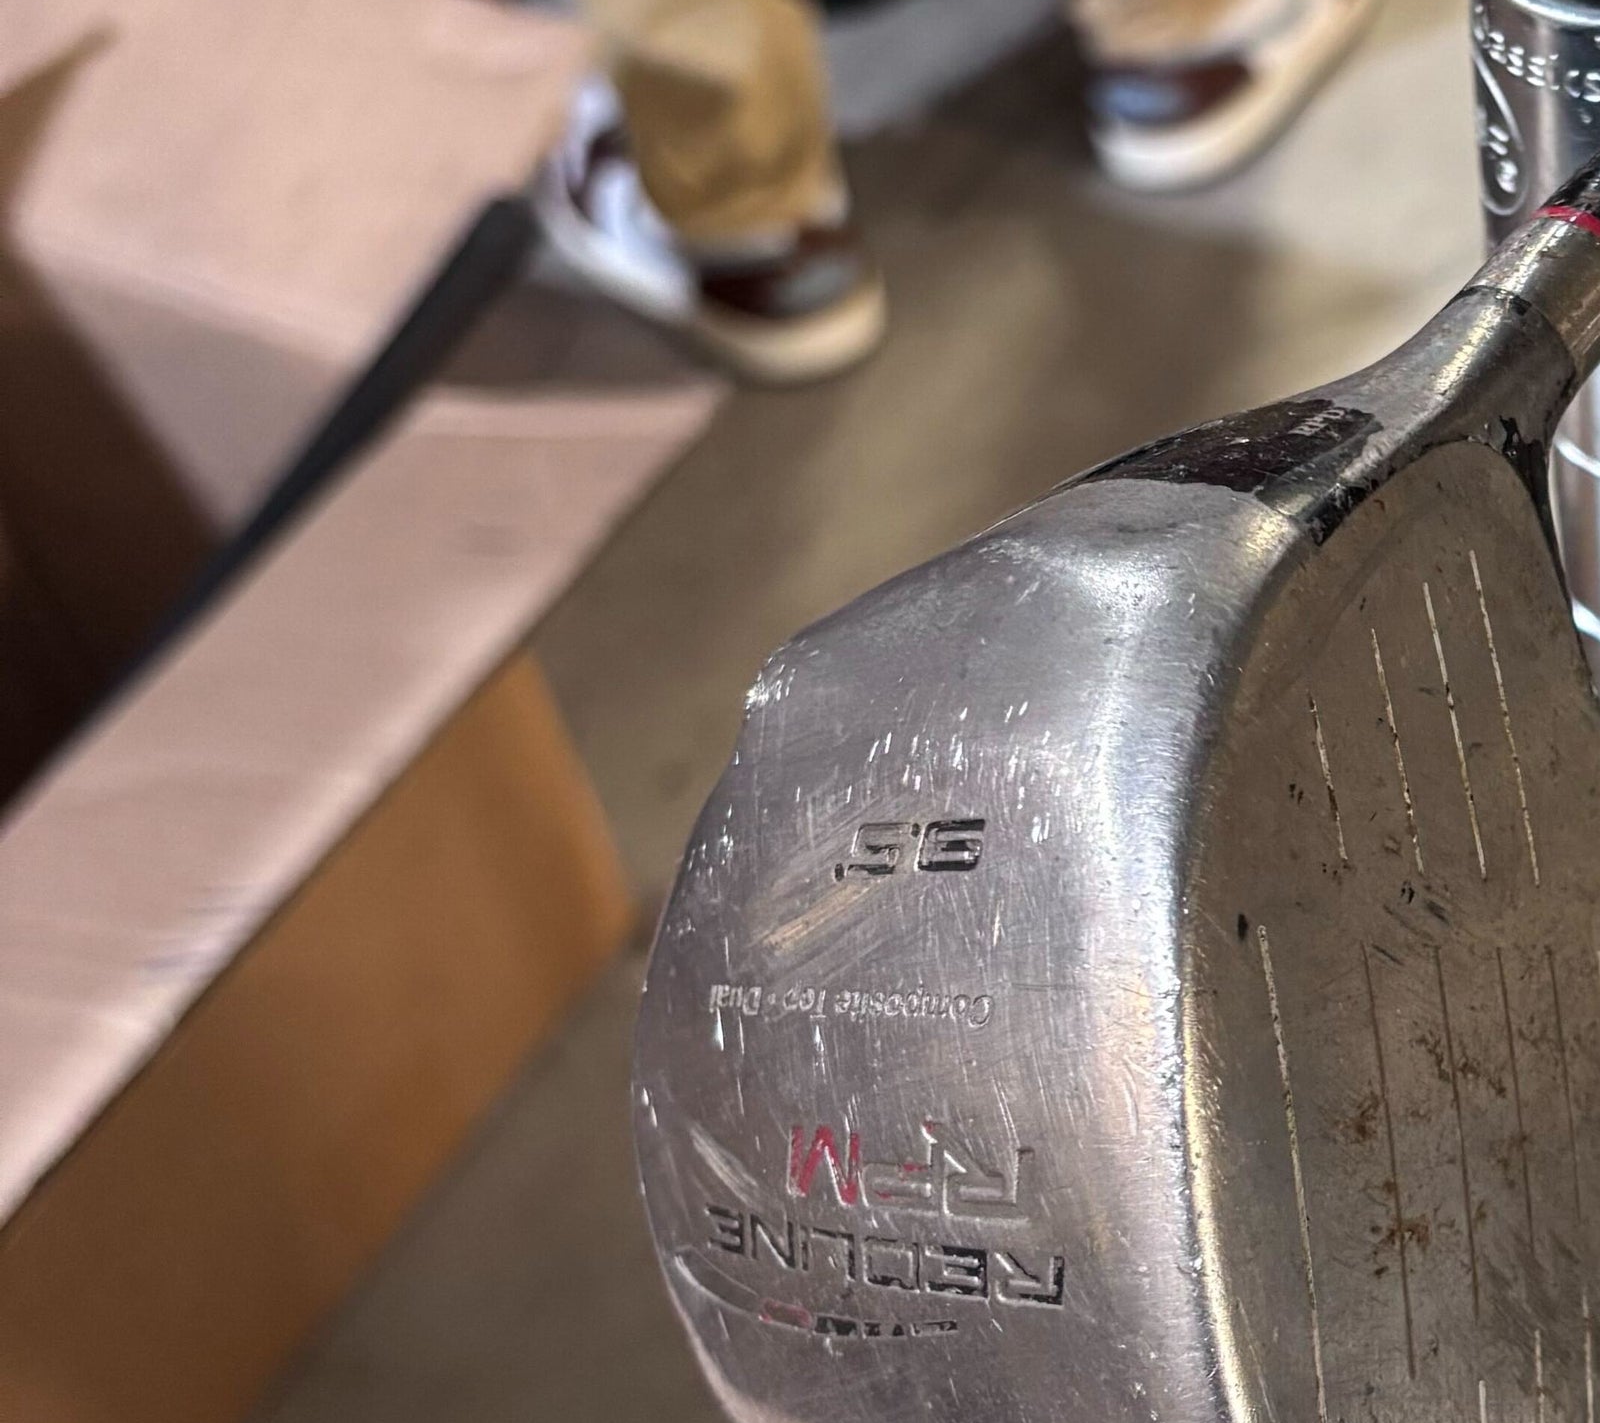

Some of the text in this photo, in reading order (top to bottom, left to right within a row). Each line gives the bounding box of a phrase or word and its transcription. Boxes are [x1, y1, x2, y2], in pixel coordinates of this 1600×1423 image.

[783, 986, 827, 1019] Top
[834, 984, 993, 1028] Composite
[787, 1122, 1034, 1224] RPM
[704, 1203, 1065, 1309] REDLINE
